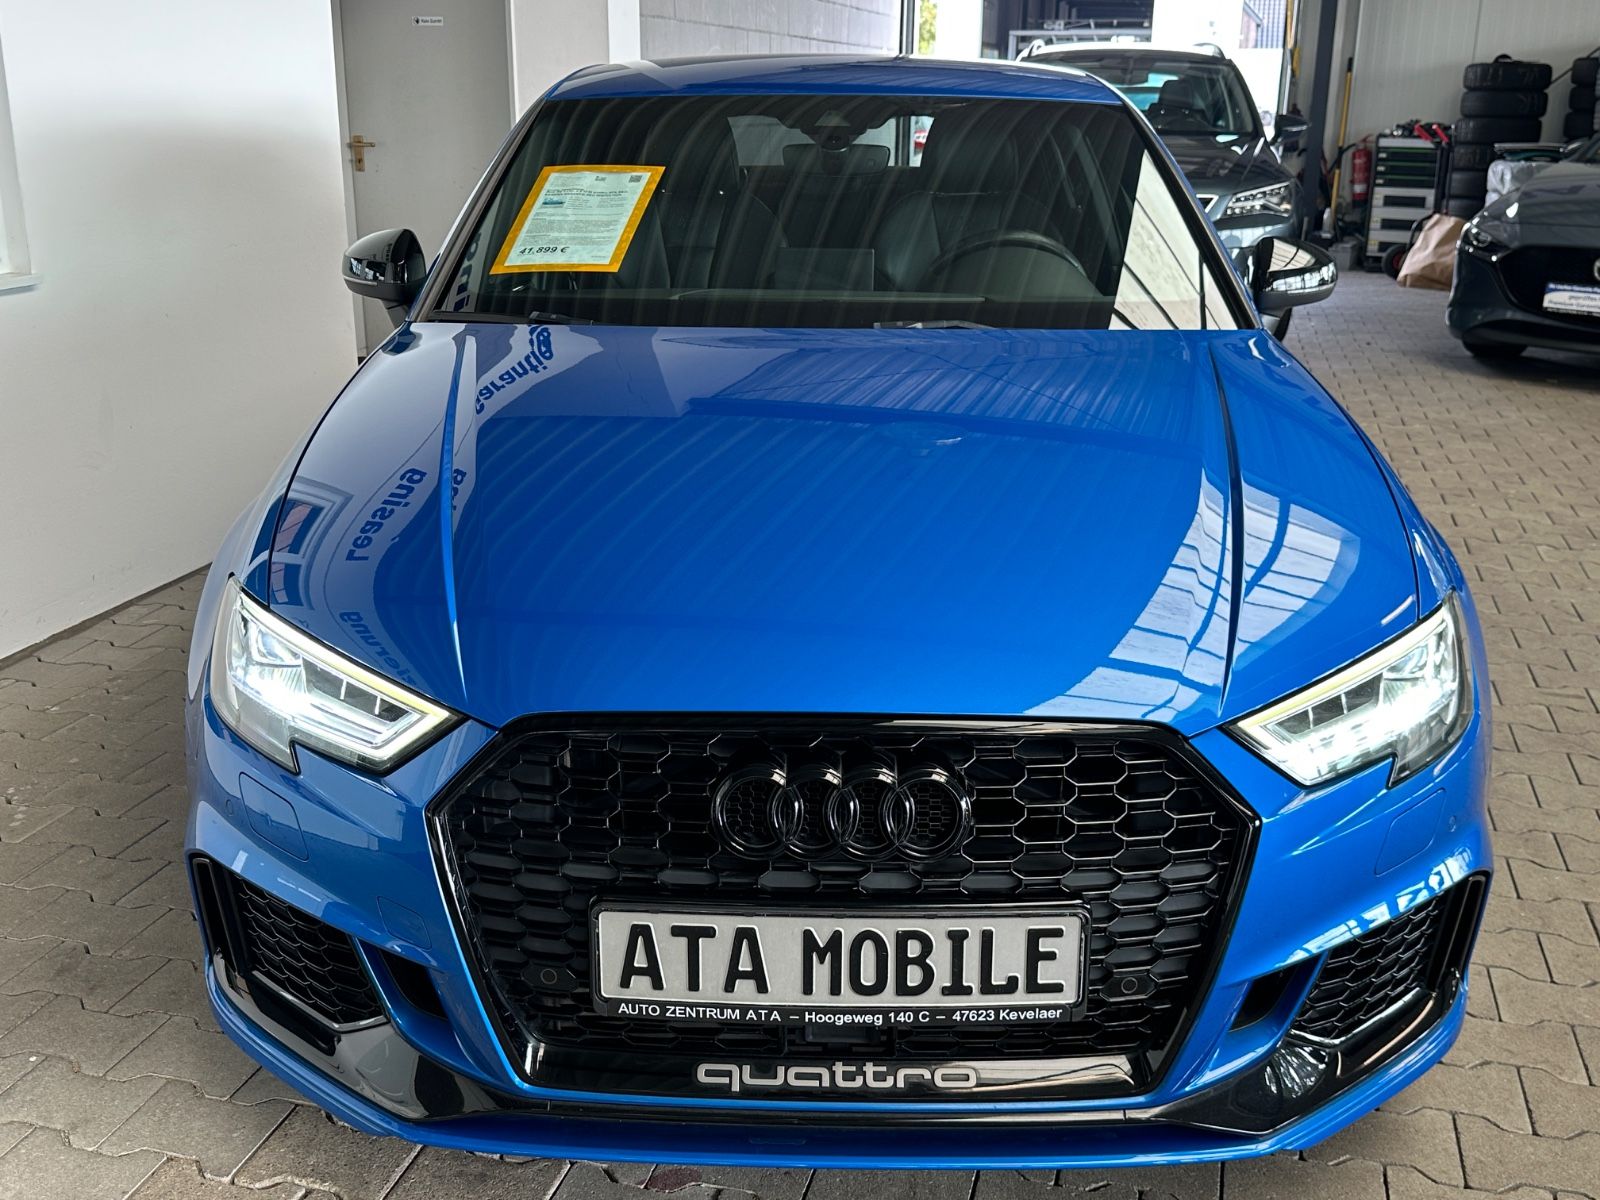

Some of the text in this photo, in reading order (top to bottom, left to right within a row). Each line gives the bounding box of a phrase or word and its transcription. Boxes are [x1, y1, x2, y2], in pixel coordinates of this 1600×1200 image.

[619, 923, 1065, 996] ATA MOBILE
[618, 1002, 661, 1017] AUTO
[665, 1005, 741, 1020] ZENTRUM
[804, 1011, 883, 1025] Hoogeweg
[888, 1011, 914, 1023] 140
[918, 1011, 930, 1023] C
[952, 1009, 995, 1022] 47623
[999, 1007, 1063, 1021] Kevelaer
[696, 1061, 977, 1092] quattro
